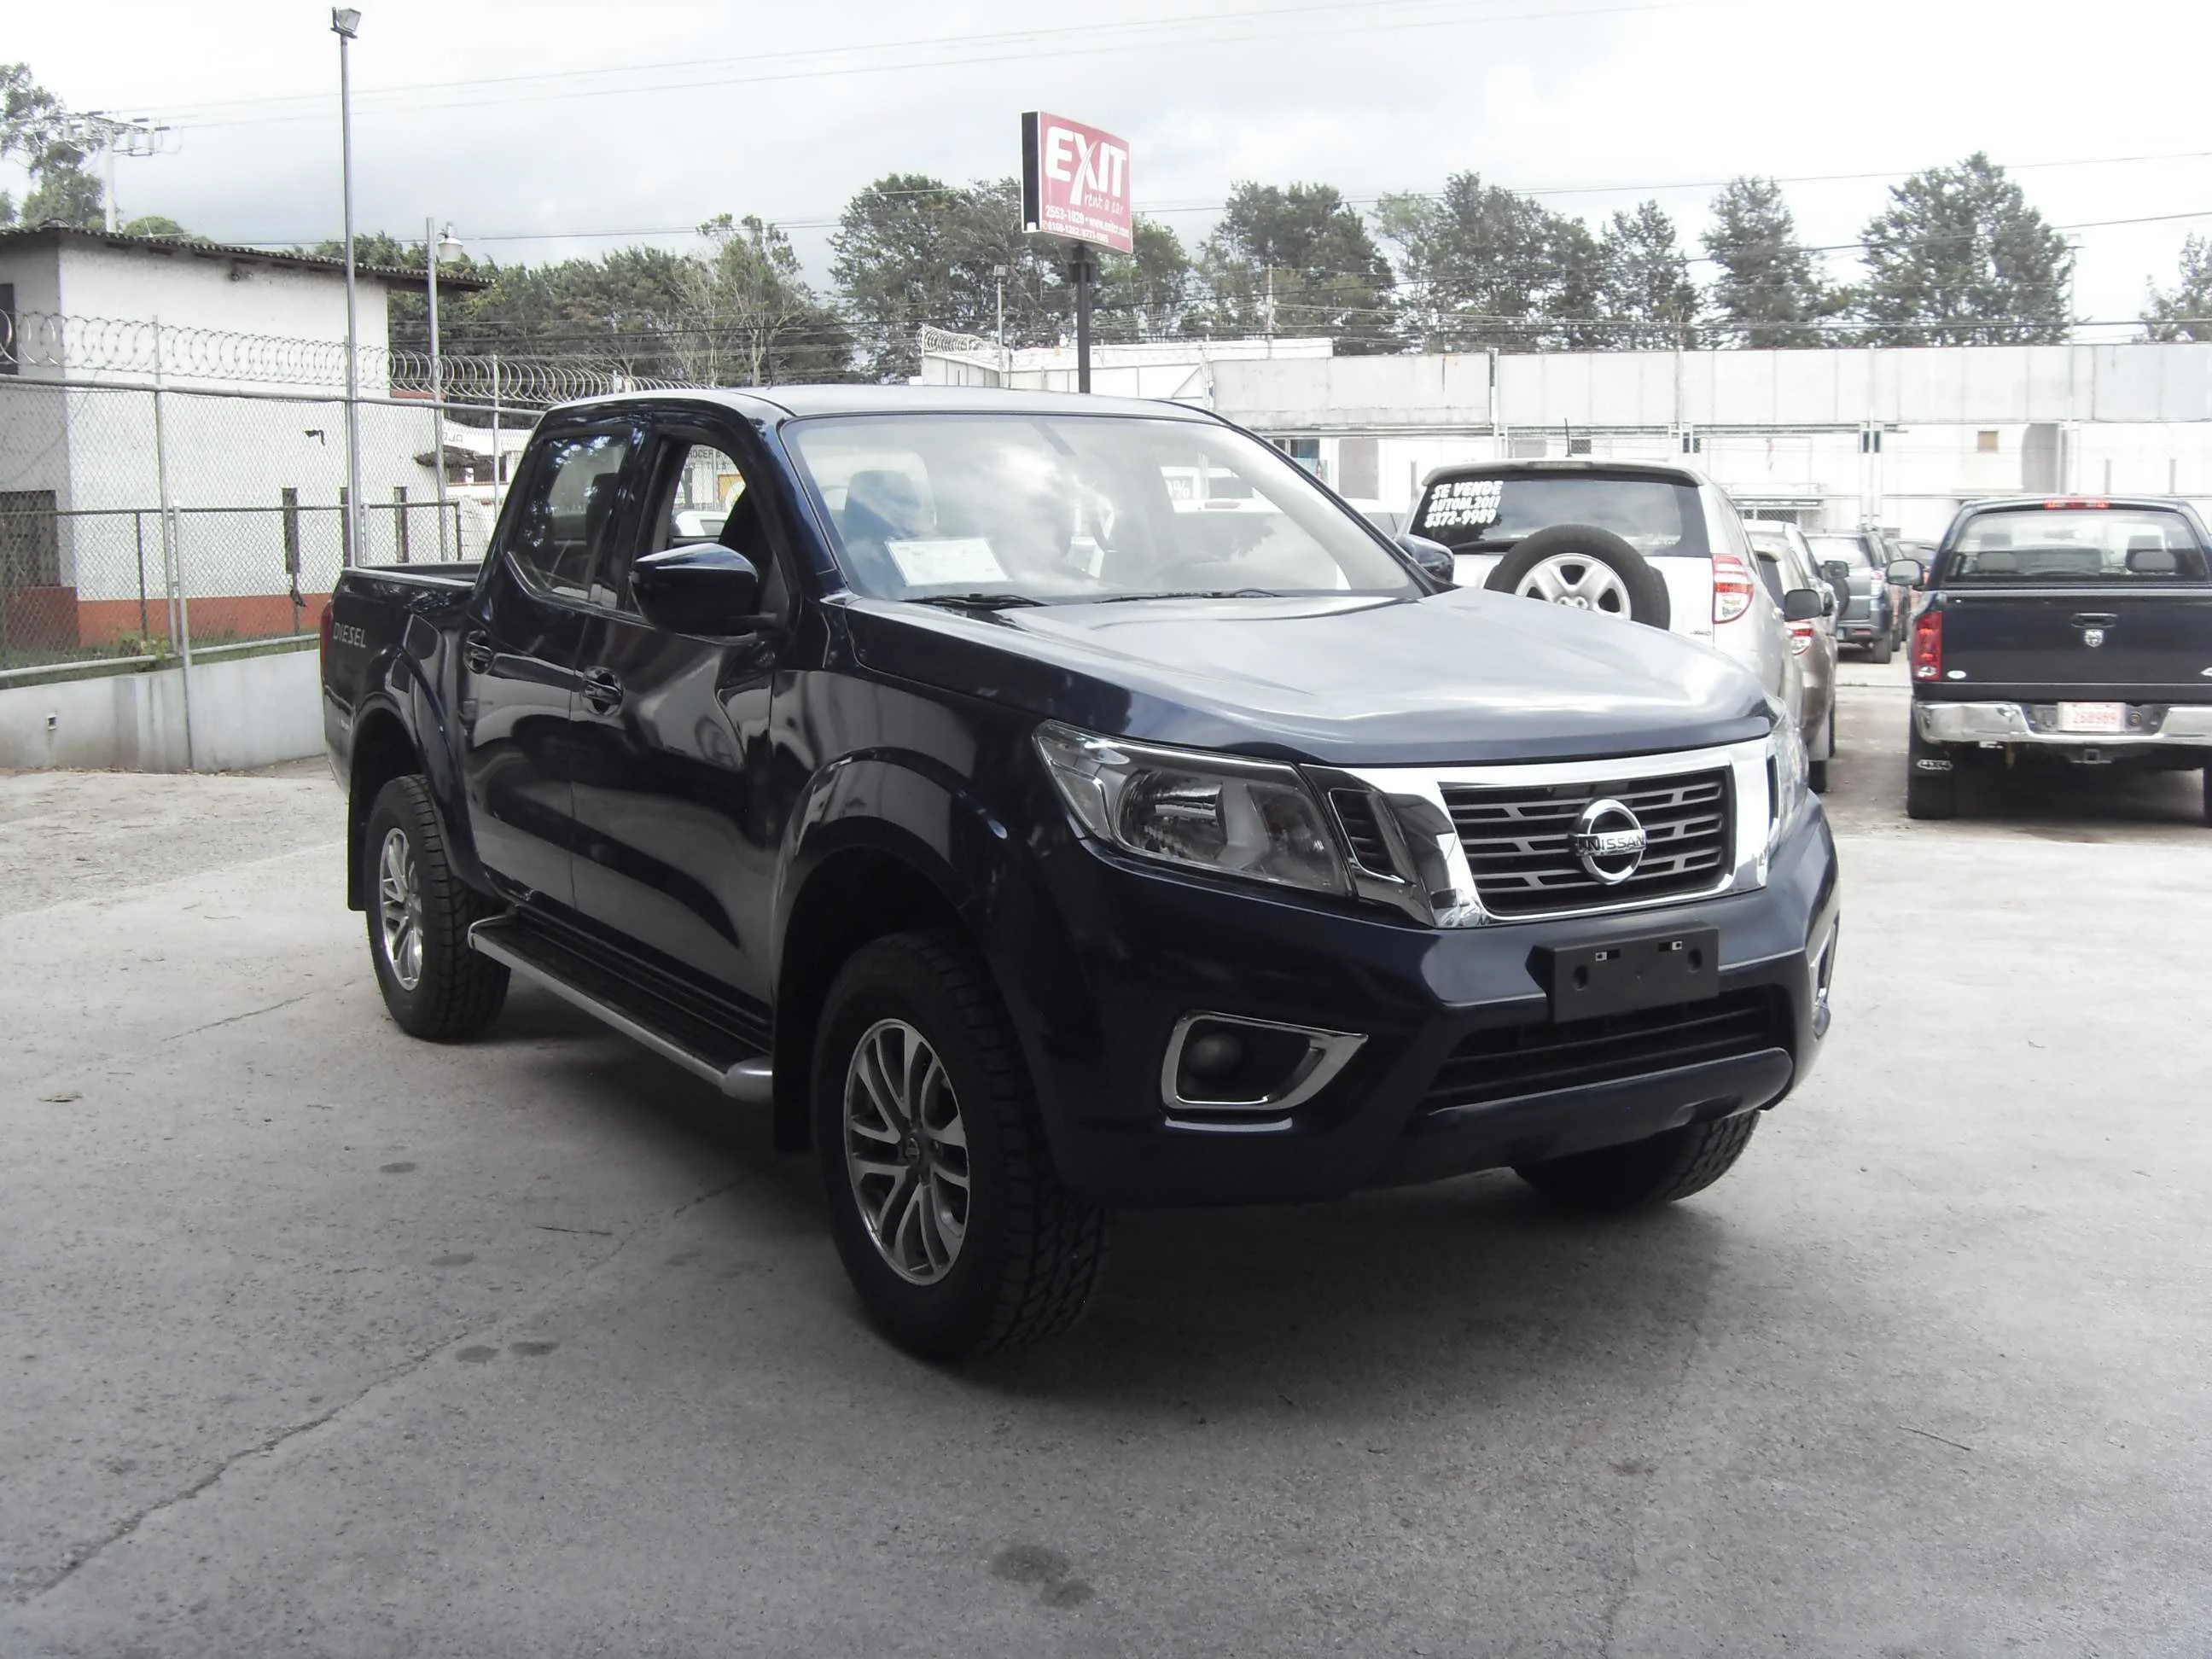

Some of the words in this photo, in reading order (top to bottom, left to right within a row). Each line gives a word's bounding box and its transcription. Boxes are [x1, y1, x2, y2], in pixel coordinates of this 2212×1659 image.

[1045, 126, 1126, 206] EXIT
[1084, 193, 1103, 211] rent
[1431, 484, 1452, 500] SE
[1453, 480, 1504, 498] VENDE
[333, 621, 366, 648] DIESEL
[1588, 836, 1644, 851] NISSAN
